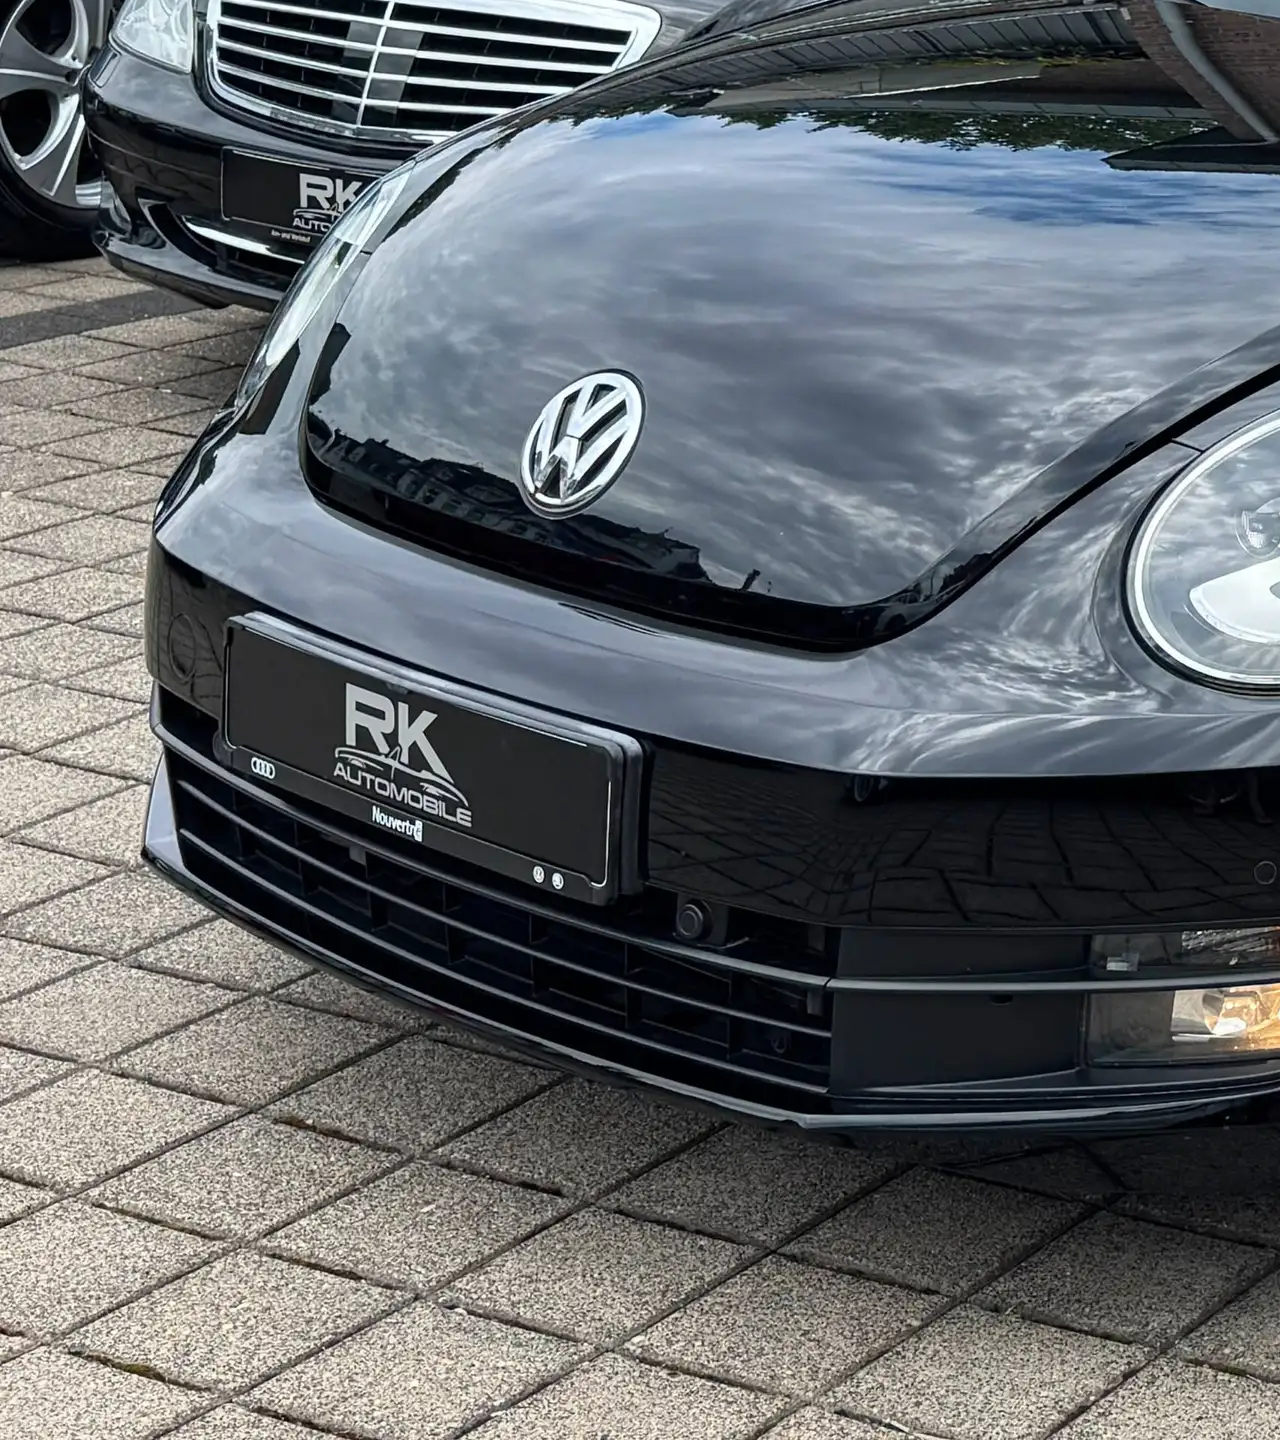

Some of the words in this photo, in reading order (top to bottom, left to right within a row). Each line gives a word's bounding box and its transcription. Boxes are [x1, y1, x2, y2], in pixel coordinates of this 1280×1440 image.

[299, 173, 363, 213] RK
[346, 682, 454, 784] RK
[333, 762, 472, 827] AUTOMOBILE
